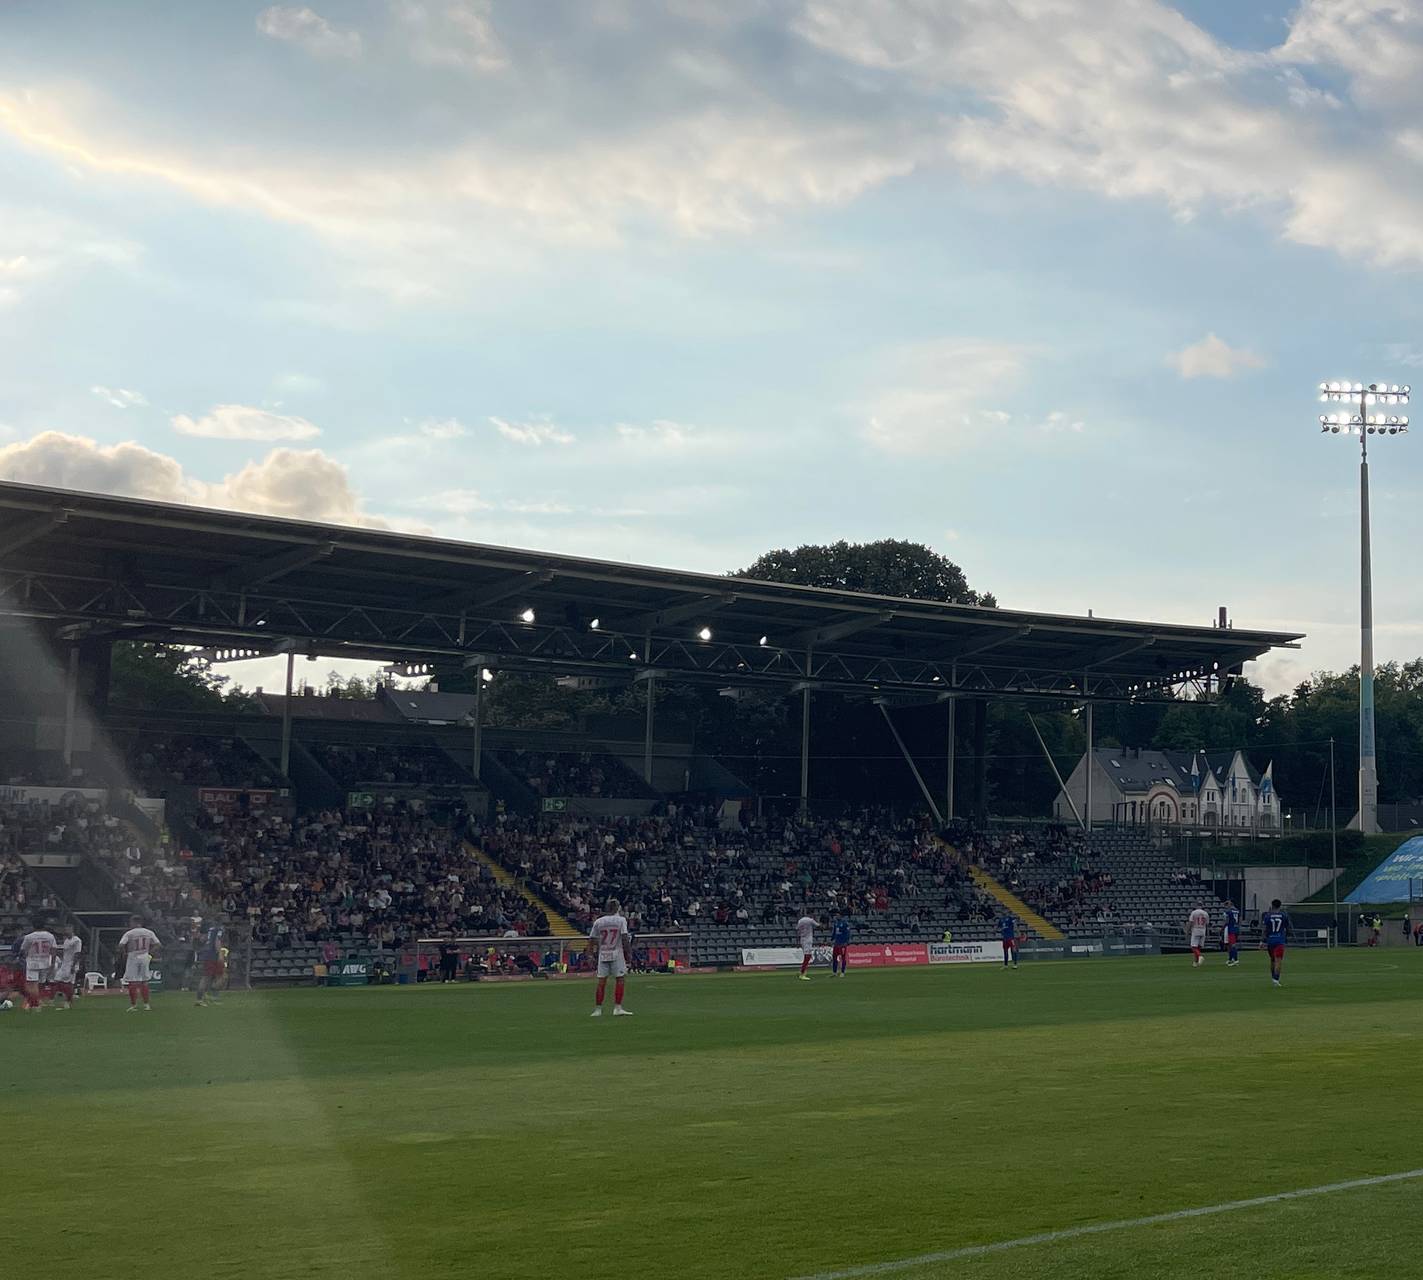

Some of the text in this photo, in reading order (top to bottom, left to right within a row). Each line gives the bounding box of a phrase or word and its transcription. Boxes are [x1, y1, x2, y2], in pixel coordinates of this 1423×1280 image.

[1270, 918, 1282, 932] 17
[600, 928, 618, 945] 27
[930, 944, 983, 954] hartmann
